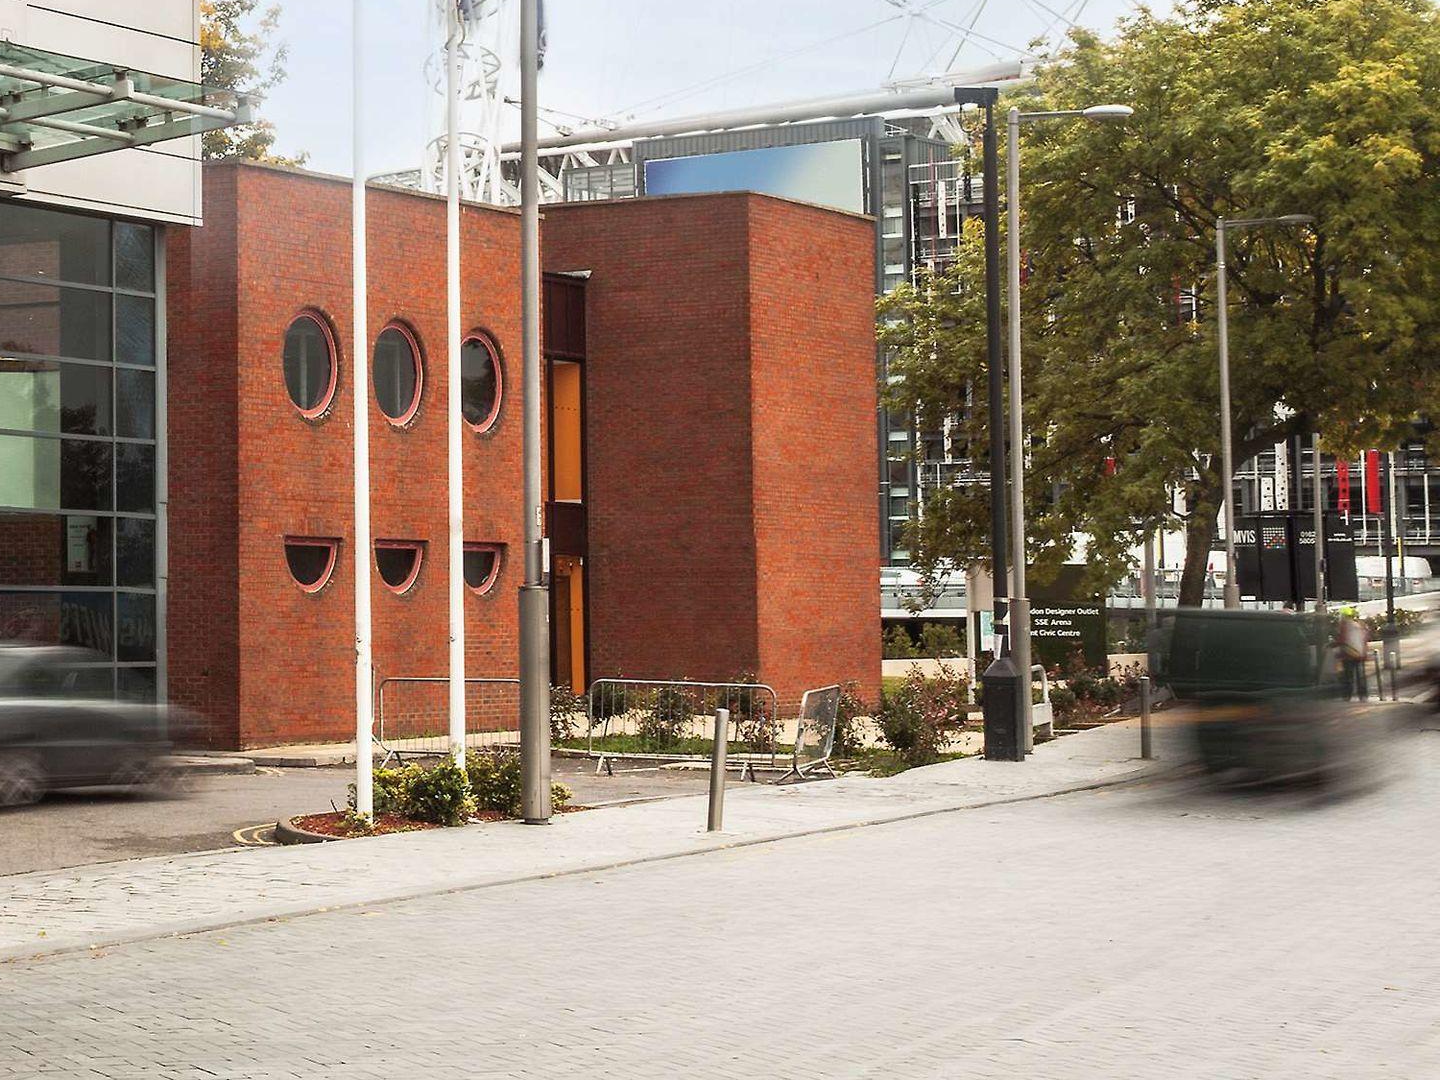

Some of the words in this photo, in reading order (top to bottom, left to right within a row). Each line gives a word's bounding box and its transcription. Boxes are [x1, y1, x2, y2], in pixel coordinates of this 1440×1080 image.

[1233, 529, 1256, 544] MVIS
[1029, 607, 1044, 616] don
[1045, 607, 1076, 617] Designer
[1076, 607, 1099, 616] Outlet
[1034, 618, 1049, 626] SSE
[1050, 618, 1072, 626] Arena
[1039, 629, 1056, 637] Civic
[1056, 629, 1081, 637] Centre
